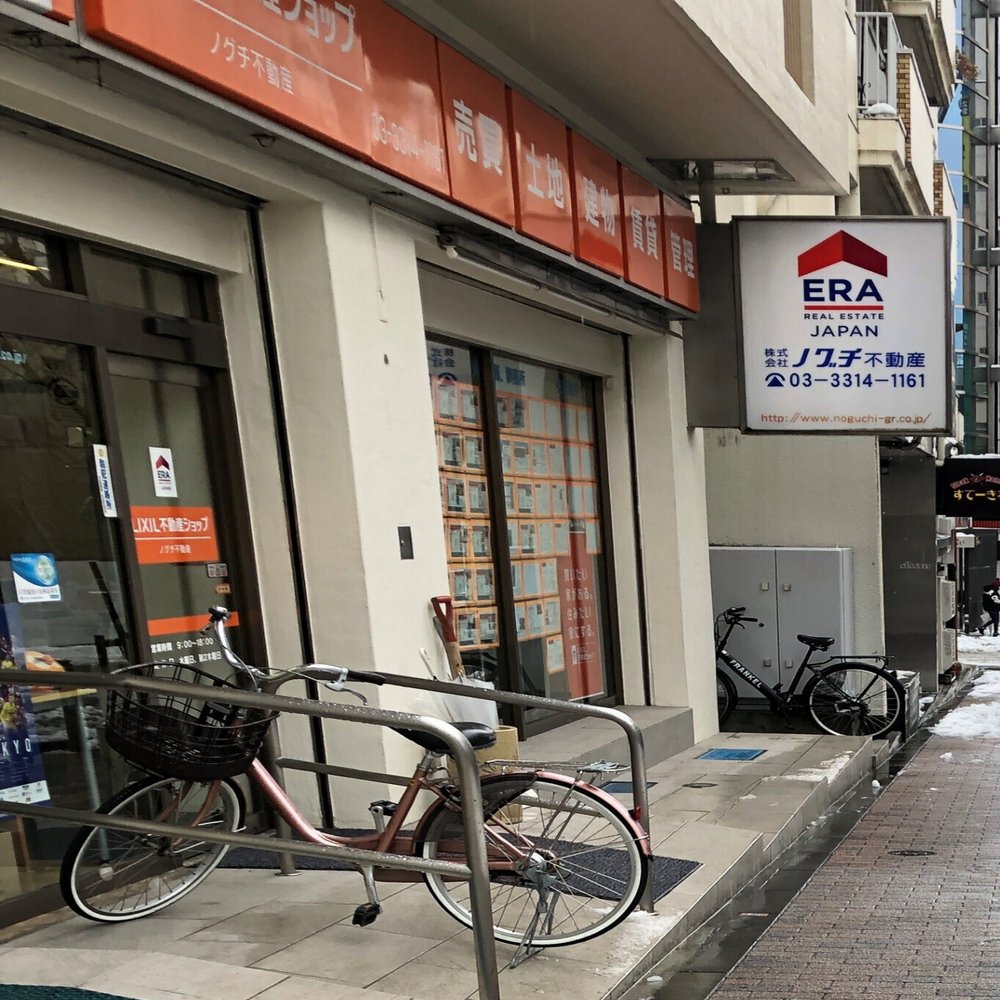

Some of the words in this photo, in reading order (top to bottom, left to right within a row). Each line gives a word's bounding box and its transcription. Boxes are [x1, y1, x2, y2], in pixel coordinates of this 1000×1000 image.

[210, 32, 295, 95] ノグチ不動産
[453, 99, 503, 176] 売買
[526, 143, 564, 208] 土地
[582, 176, 615, 236] 建物
[803, 279, 883, 302] ERA
[810, 325, 879, 337] JAPAN
[764, 348, 788, 357] 株式
[764, 358, 789, 368] 会社
[792, 348, 926, 368] ノグチ不動産
[761, 412, 932, 424] http://www.noguchi-gr.co.jp/
[157, 470, 171, 479] ERA
[730, 659, 762, 688] FRANKEL
